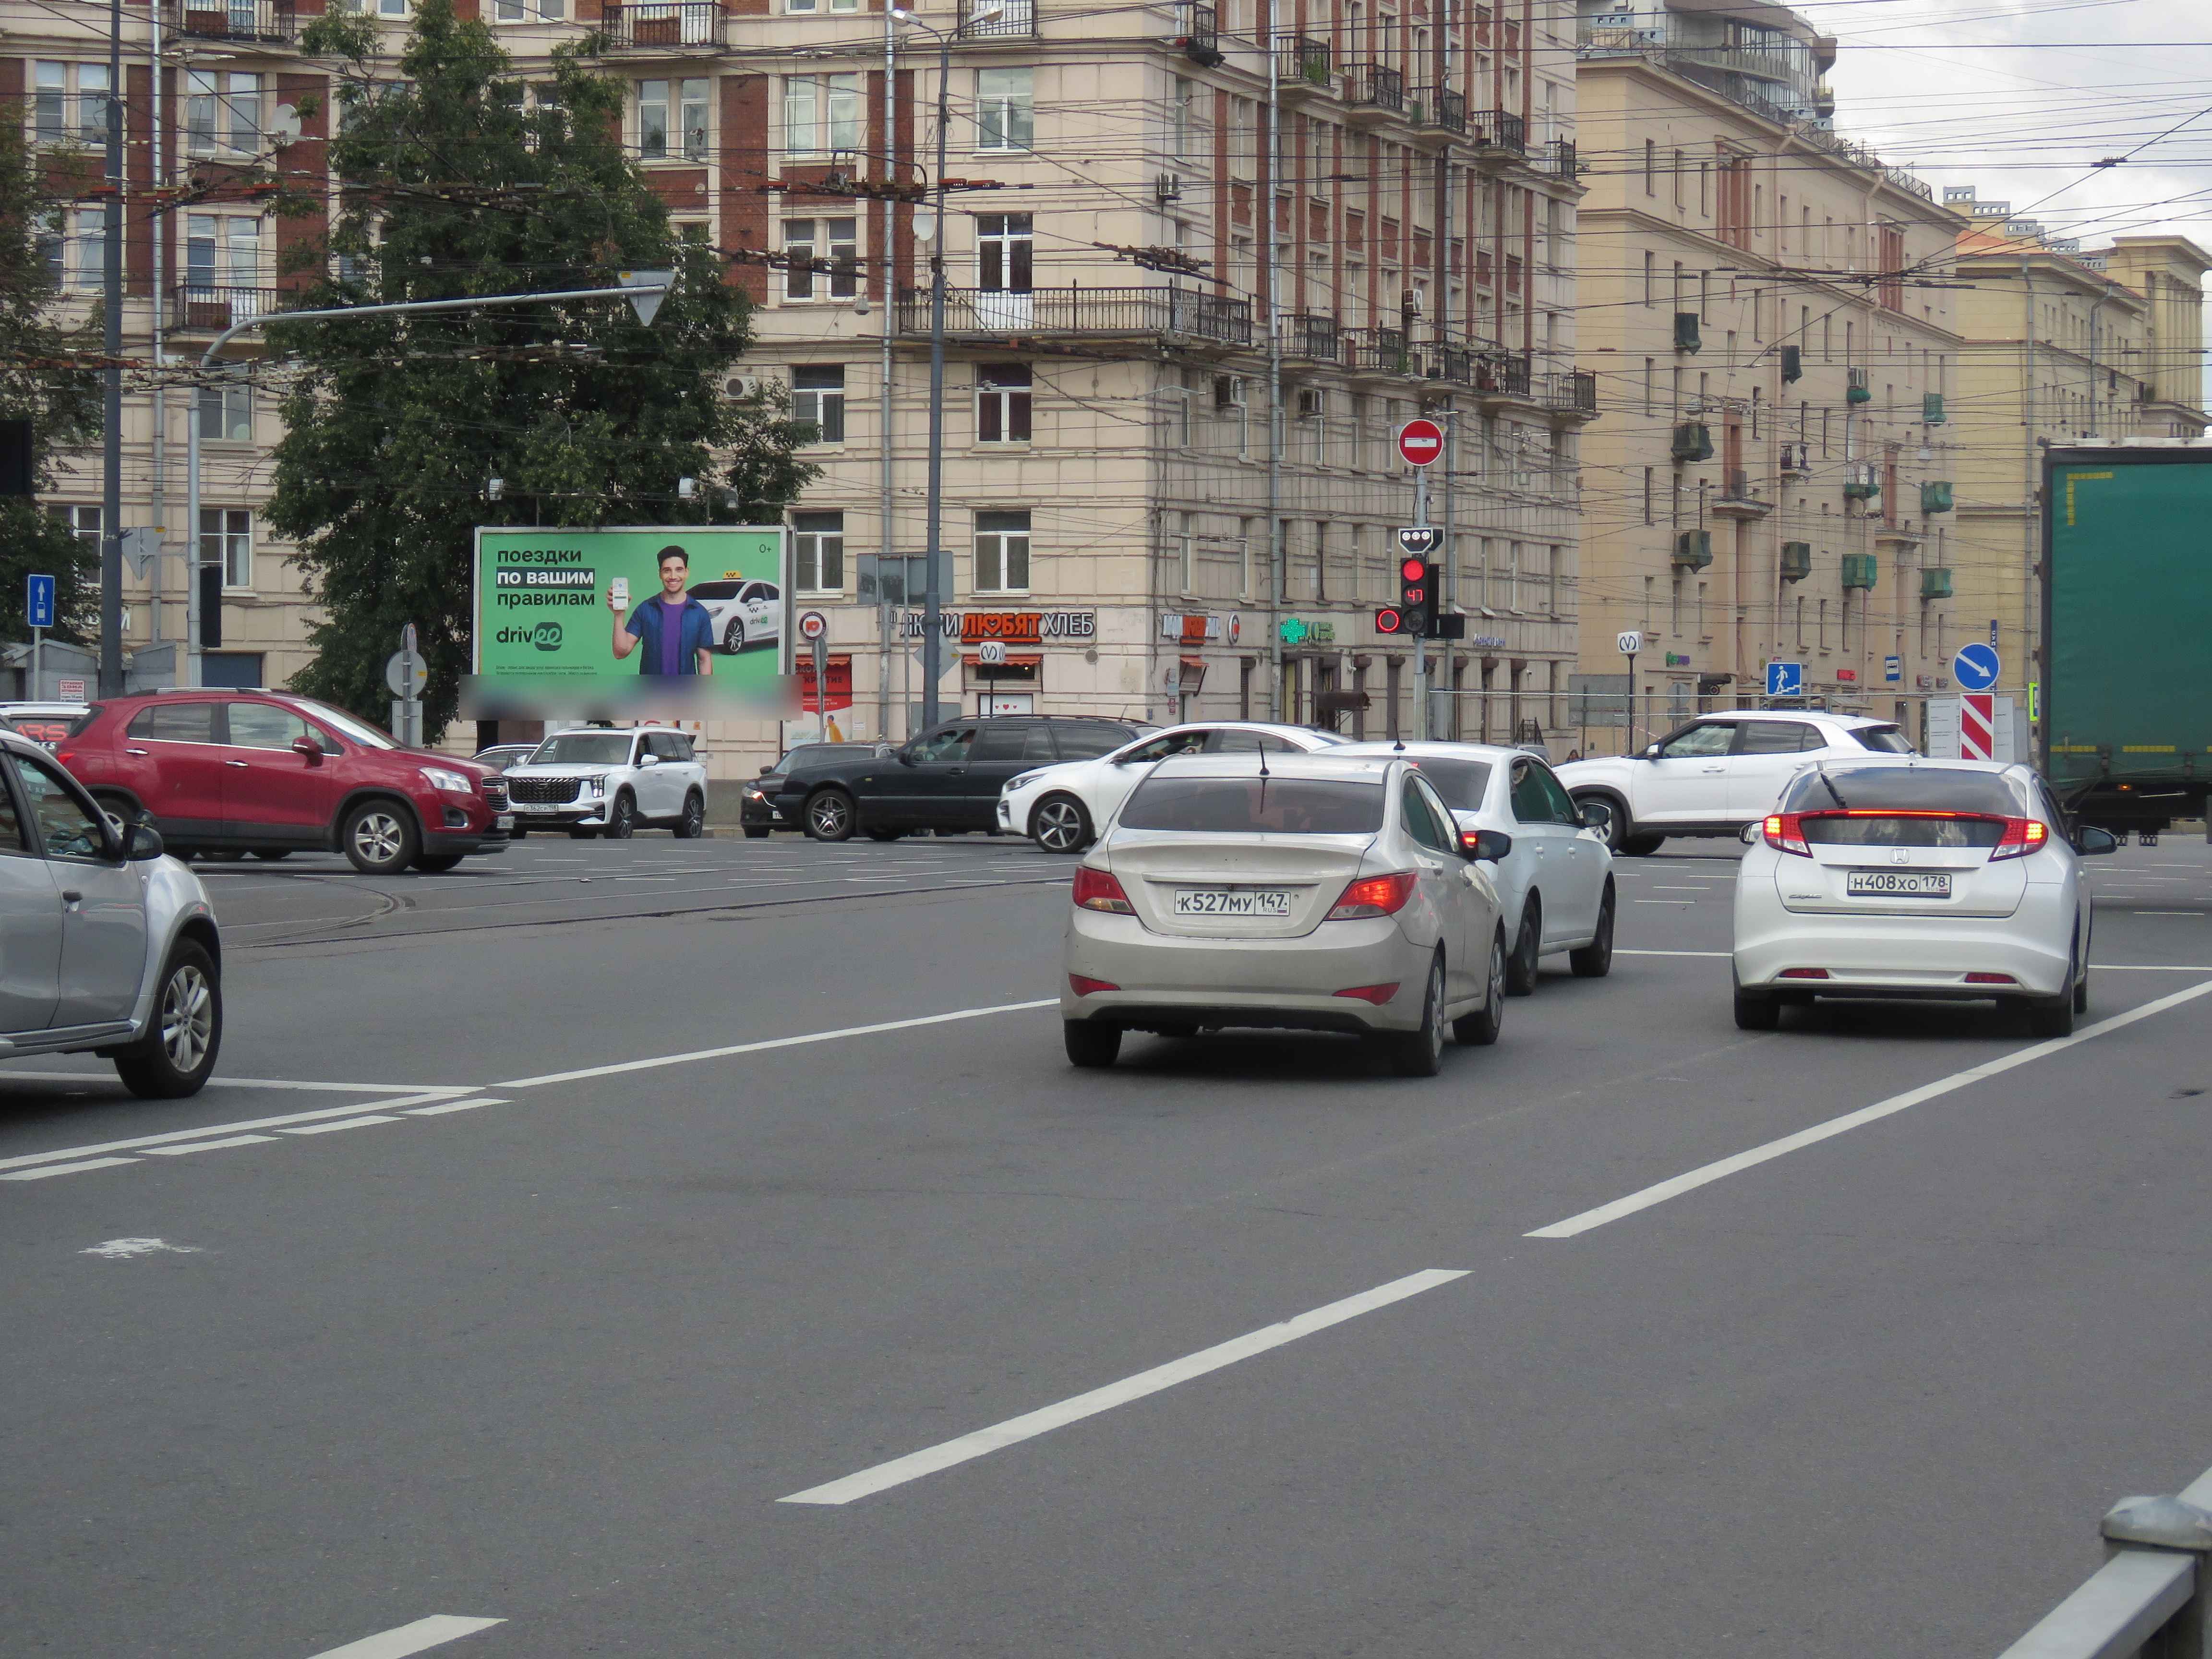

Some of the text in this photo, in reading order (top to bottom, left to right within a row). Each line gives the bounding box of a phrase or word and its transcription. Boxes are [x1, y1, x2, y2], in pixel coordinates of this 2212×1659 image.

[759, 544, 771, 553] 0+
[497, 550, 581, 565] поездки
[497, 572, 593, 584] по вашим
[497, 593, 595, 610] правилам
[1407, 589, 1423, 601] 47
[962, 613, 1041, 637] ЛЮБЯТ
[1043, 613, 1094, 637] ХЛЕБ
[496, 625, 562, 648] drivee
[1854, 875, 1945, 890] Н408ХО 178
[1180, 893, 1285, 912] К527МУ 147
